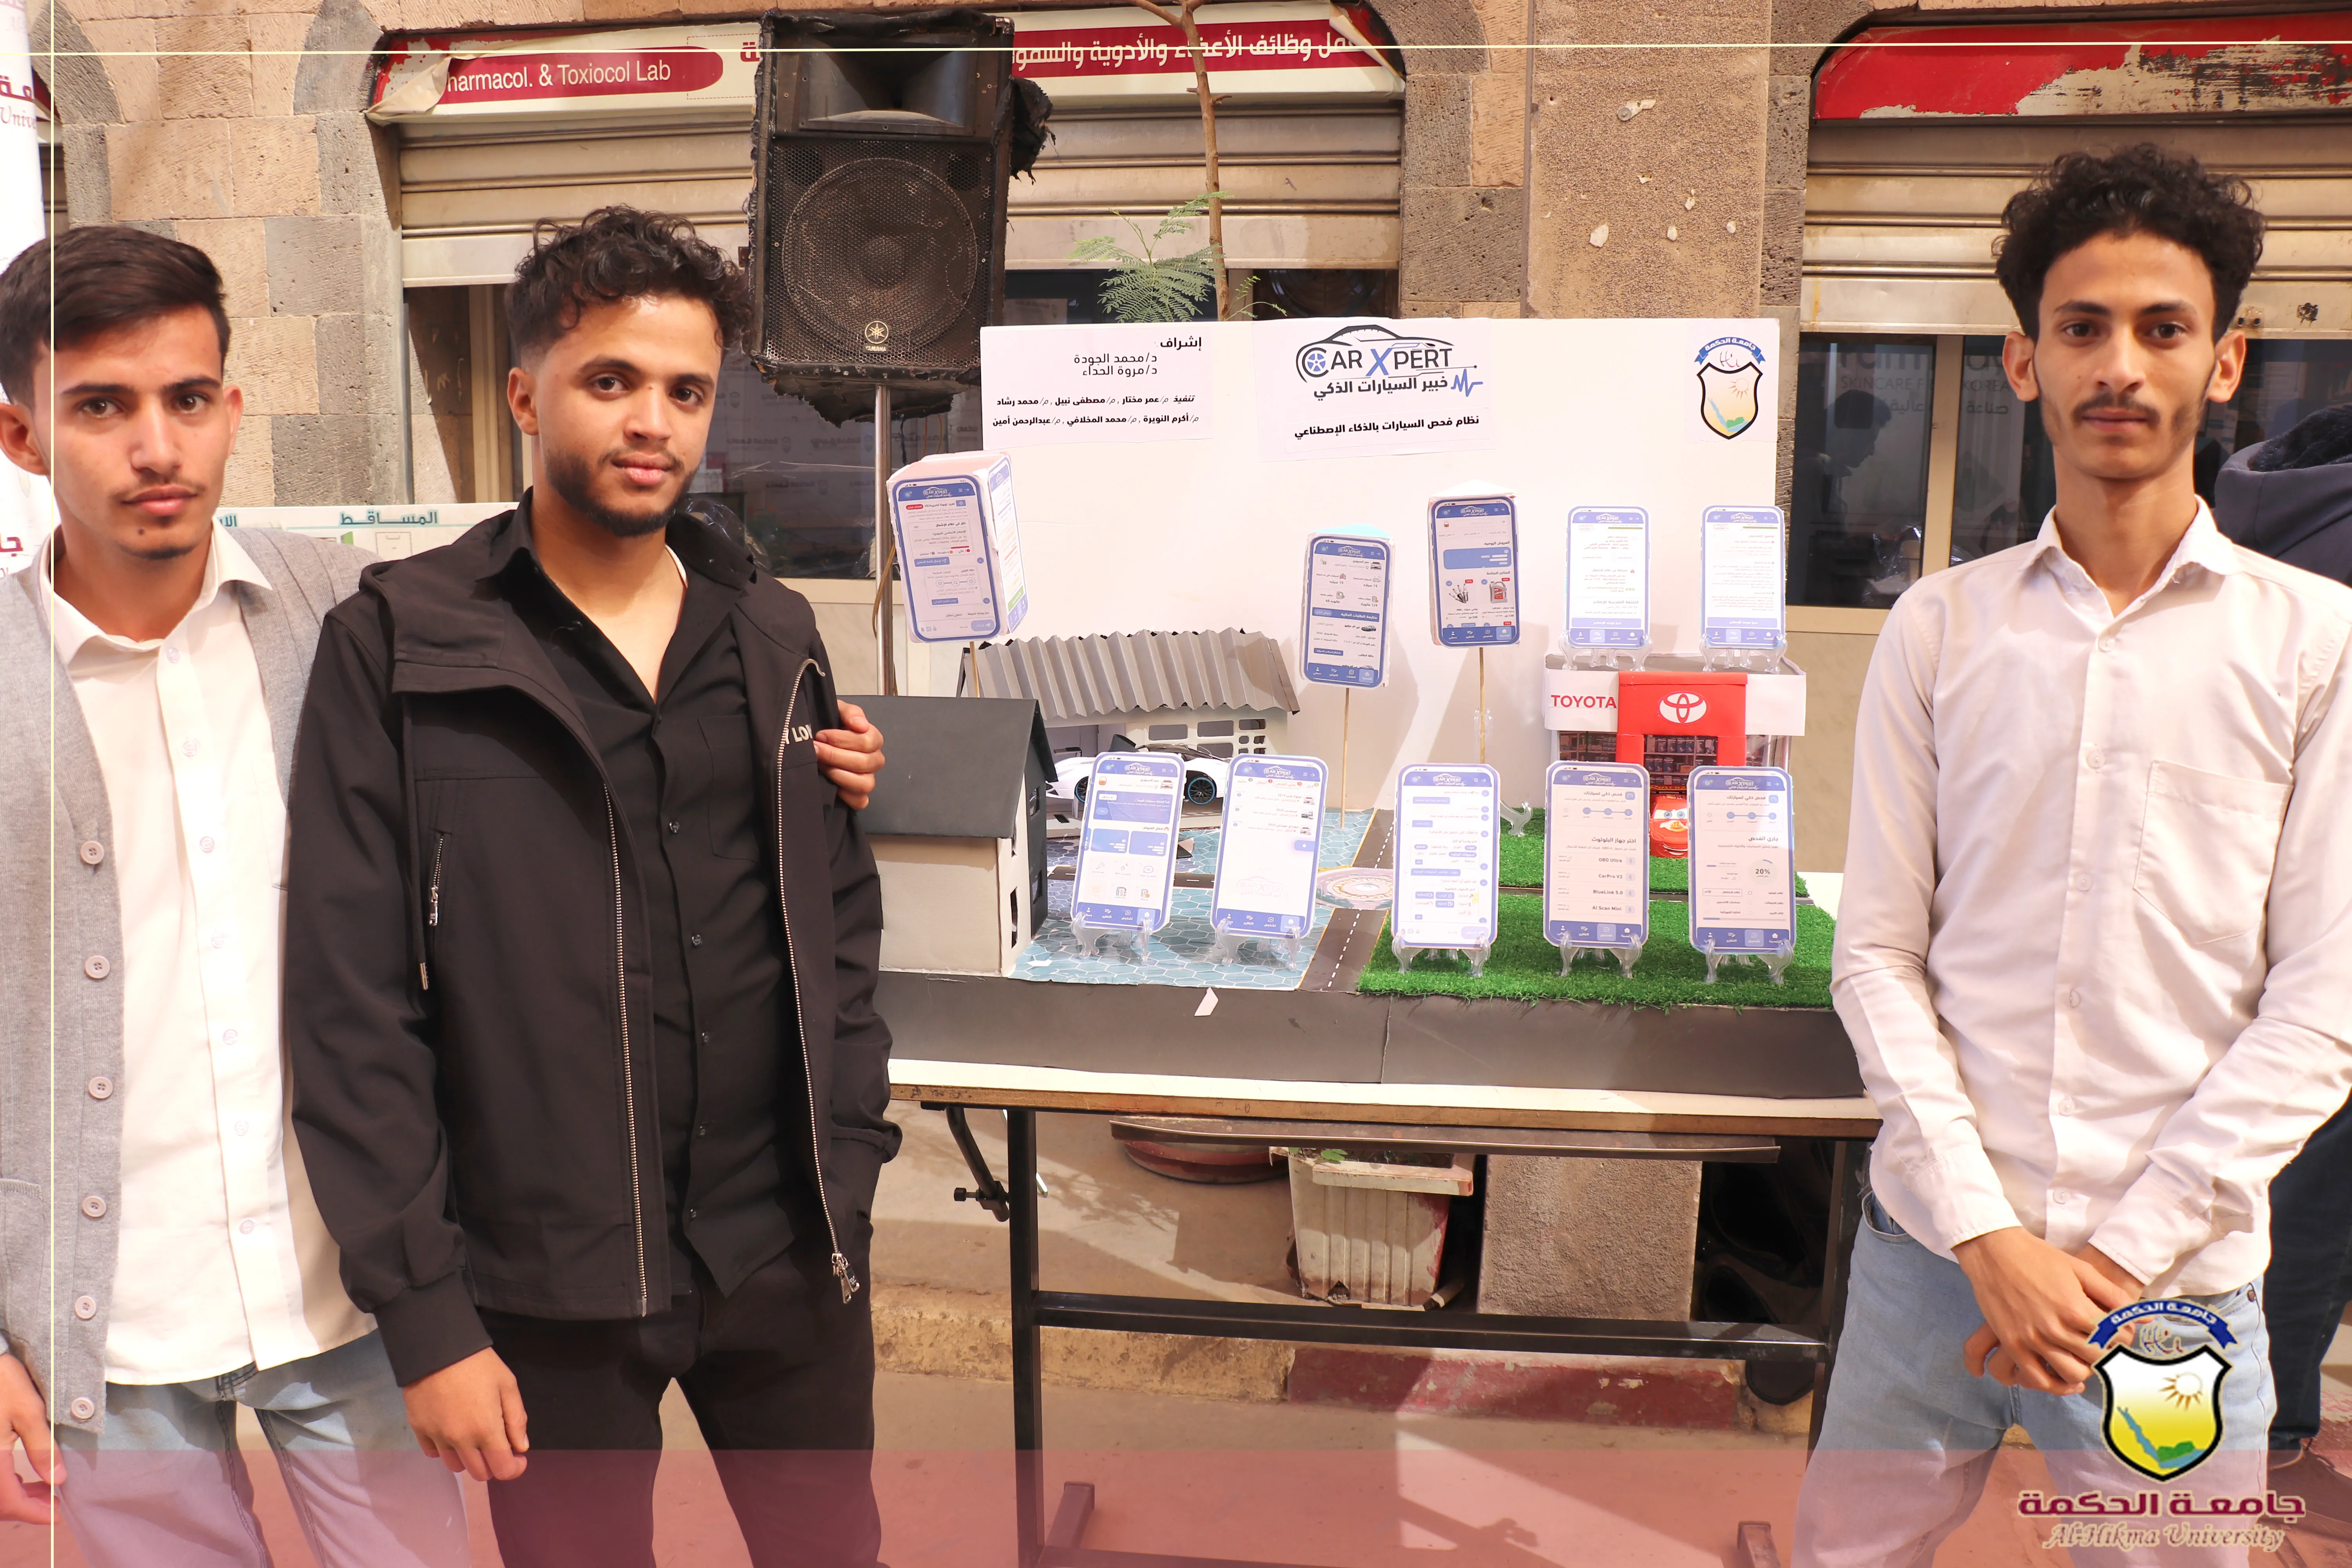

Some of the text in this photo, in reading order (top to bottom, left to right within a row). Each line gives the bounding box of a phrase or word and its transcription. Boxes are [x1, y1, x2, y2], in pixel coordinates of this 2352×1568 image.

[1090, 33, 1167, 67] والأدوية
[1250, 34, 1312, 62] وظائف
[1013, 41, 1084, 71] والسمو
[447, 59, 671, 92] harmacol. & Toxiocol Lab
[1160, 336, 1202, 351] إشراف
[1705, 338, 1756, 351] جامعة الحكمة
[1074, 353, 1109, 366] الجودة
[1314, 376, 1448, 401] خبير السيارات الذكي
[1841, 376, 1912, 390] SKINCARE
[997, 397, 1015, 406] رشاد
[1055, 397, 1071, 406] نبيل
[1122, 396, 1143, 404] مختار
[993, 416, 1010, 426] أمين
[1067, 416, 1102, 426] المخلافي
[1294, 416, 1479, 439] نظام فحص السيارات بالذكاء الإصطناعي
[341, 511, 437, 526] المساقط
[1551, 695, 1617, 708] TOYOTA
